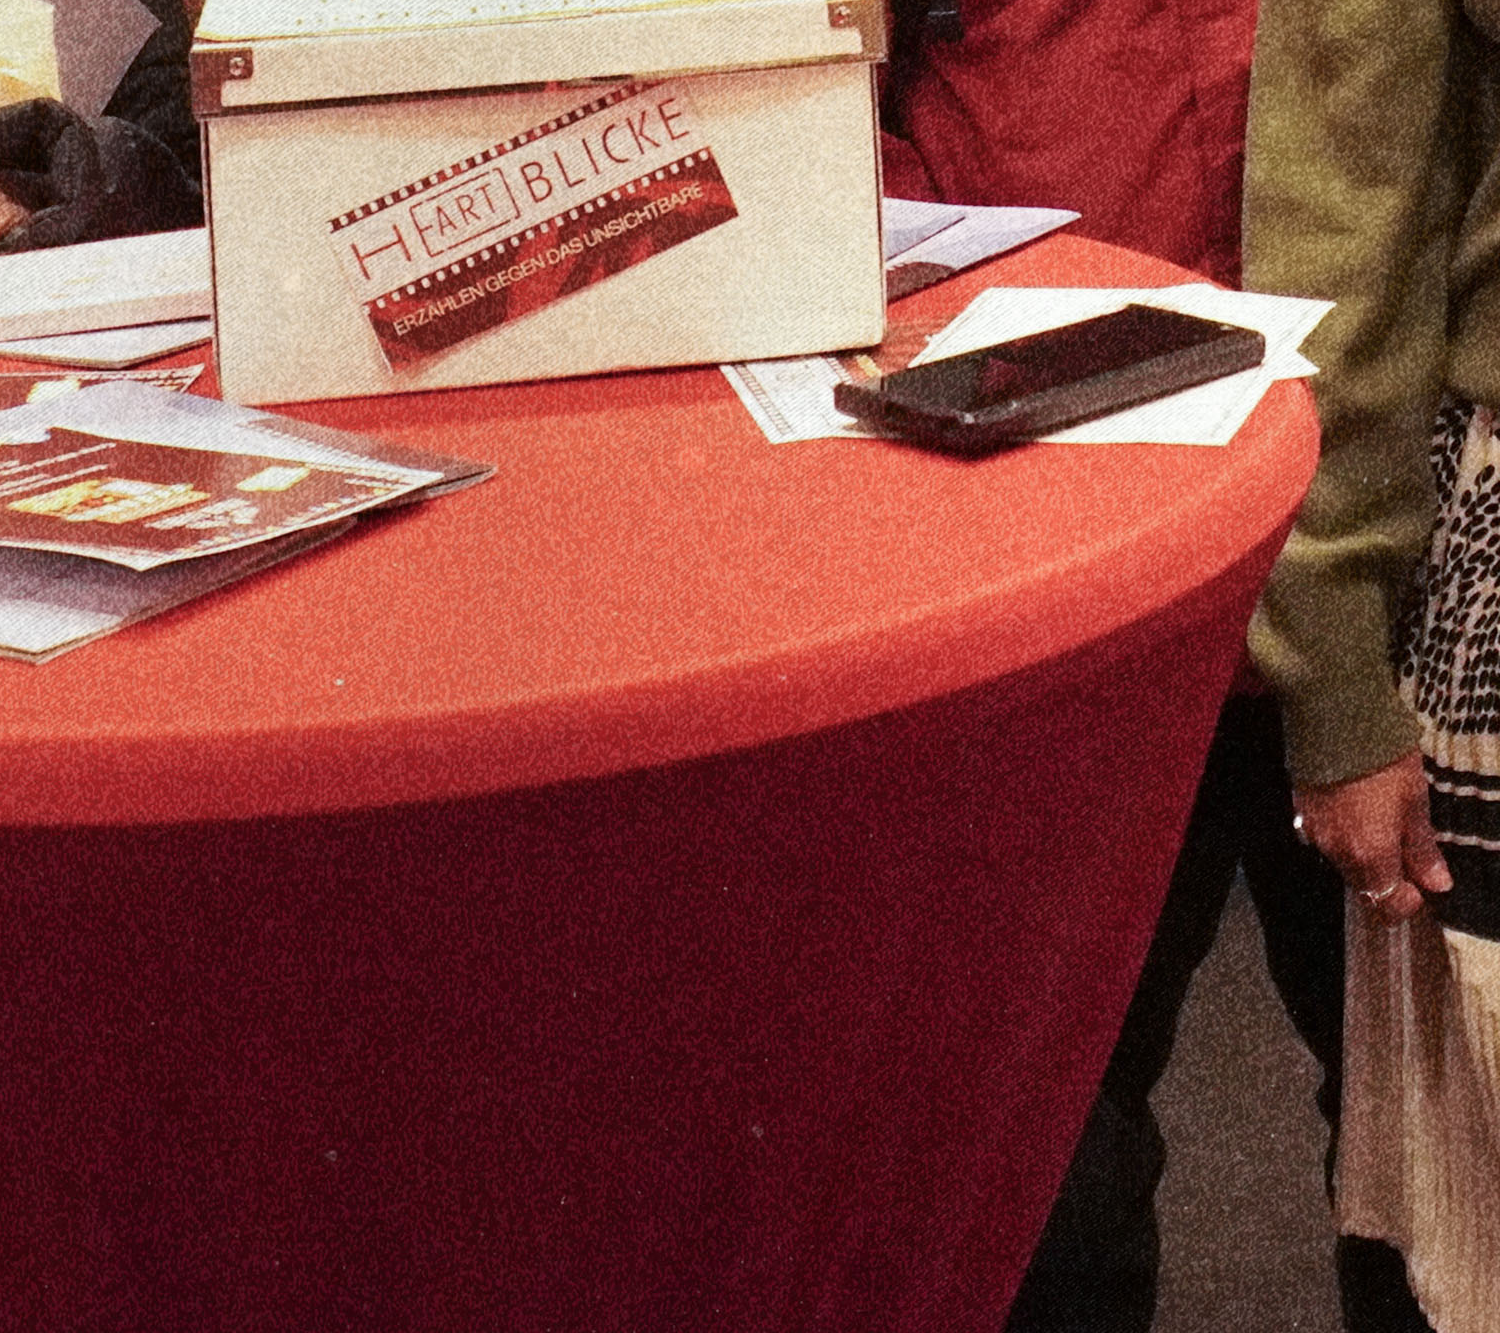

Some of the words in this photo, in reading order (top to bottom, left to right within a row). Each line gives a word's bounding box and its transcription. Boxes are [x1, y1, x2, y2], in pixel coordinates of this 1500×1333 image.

[485, 255, 547, 294] GEGEN
[546, 236, 584, 265] DAS
[584, 183, 705, 248] UNSICHTBARE
